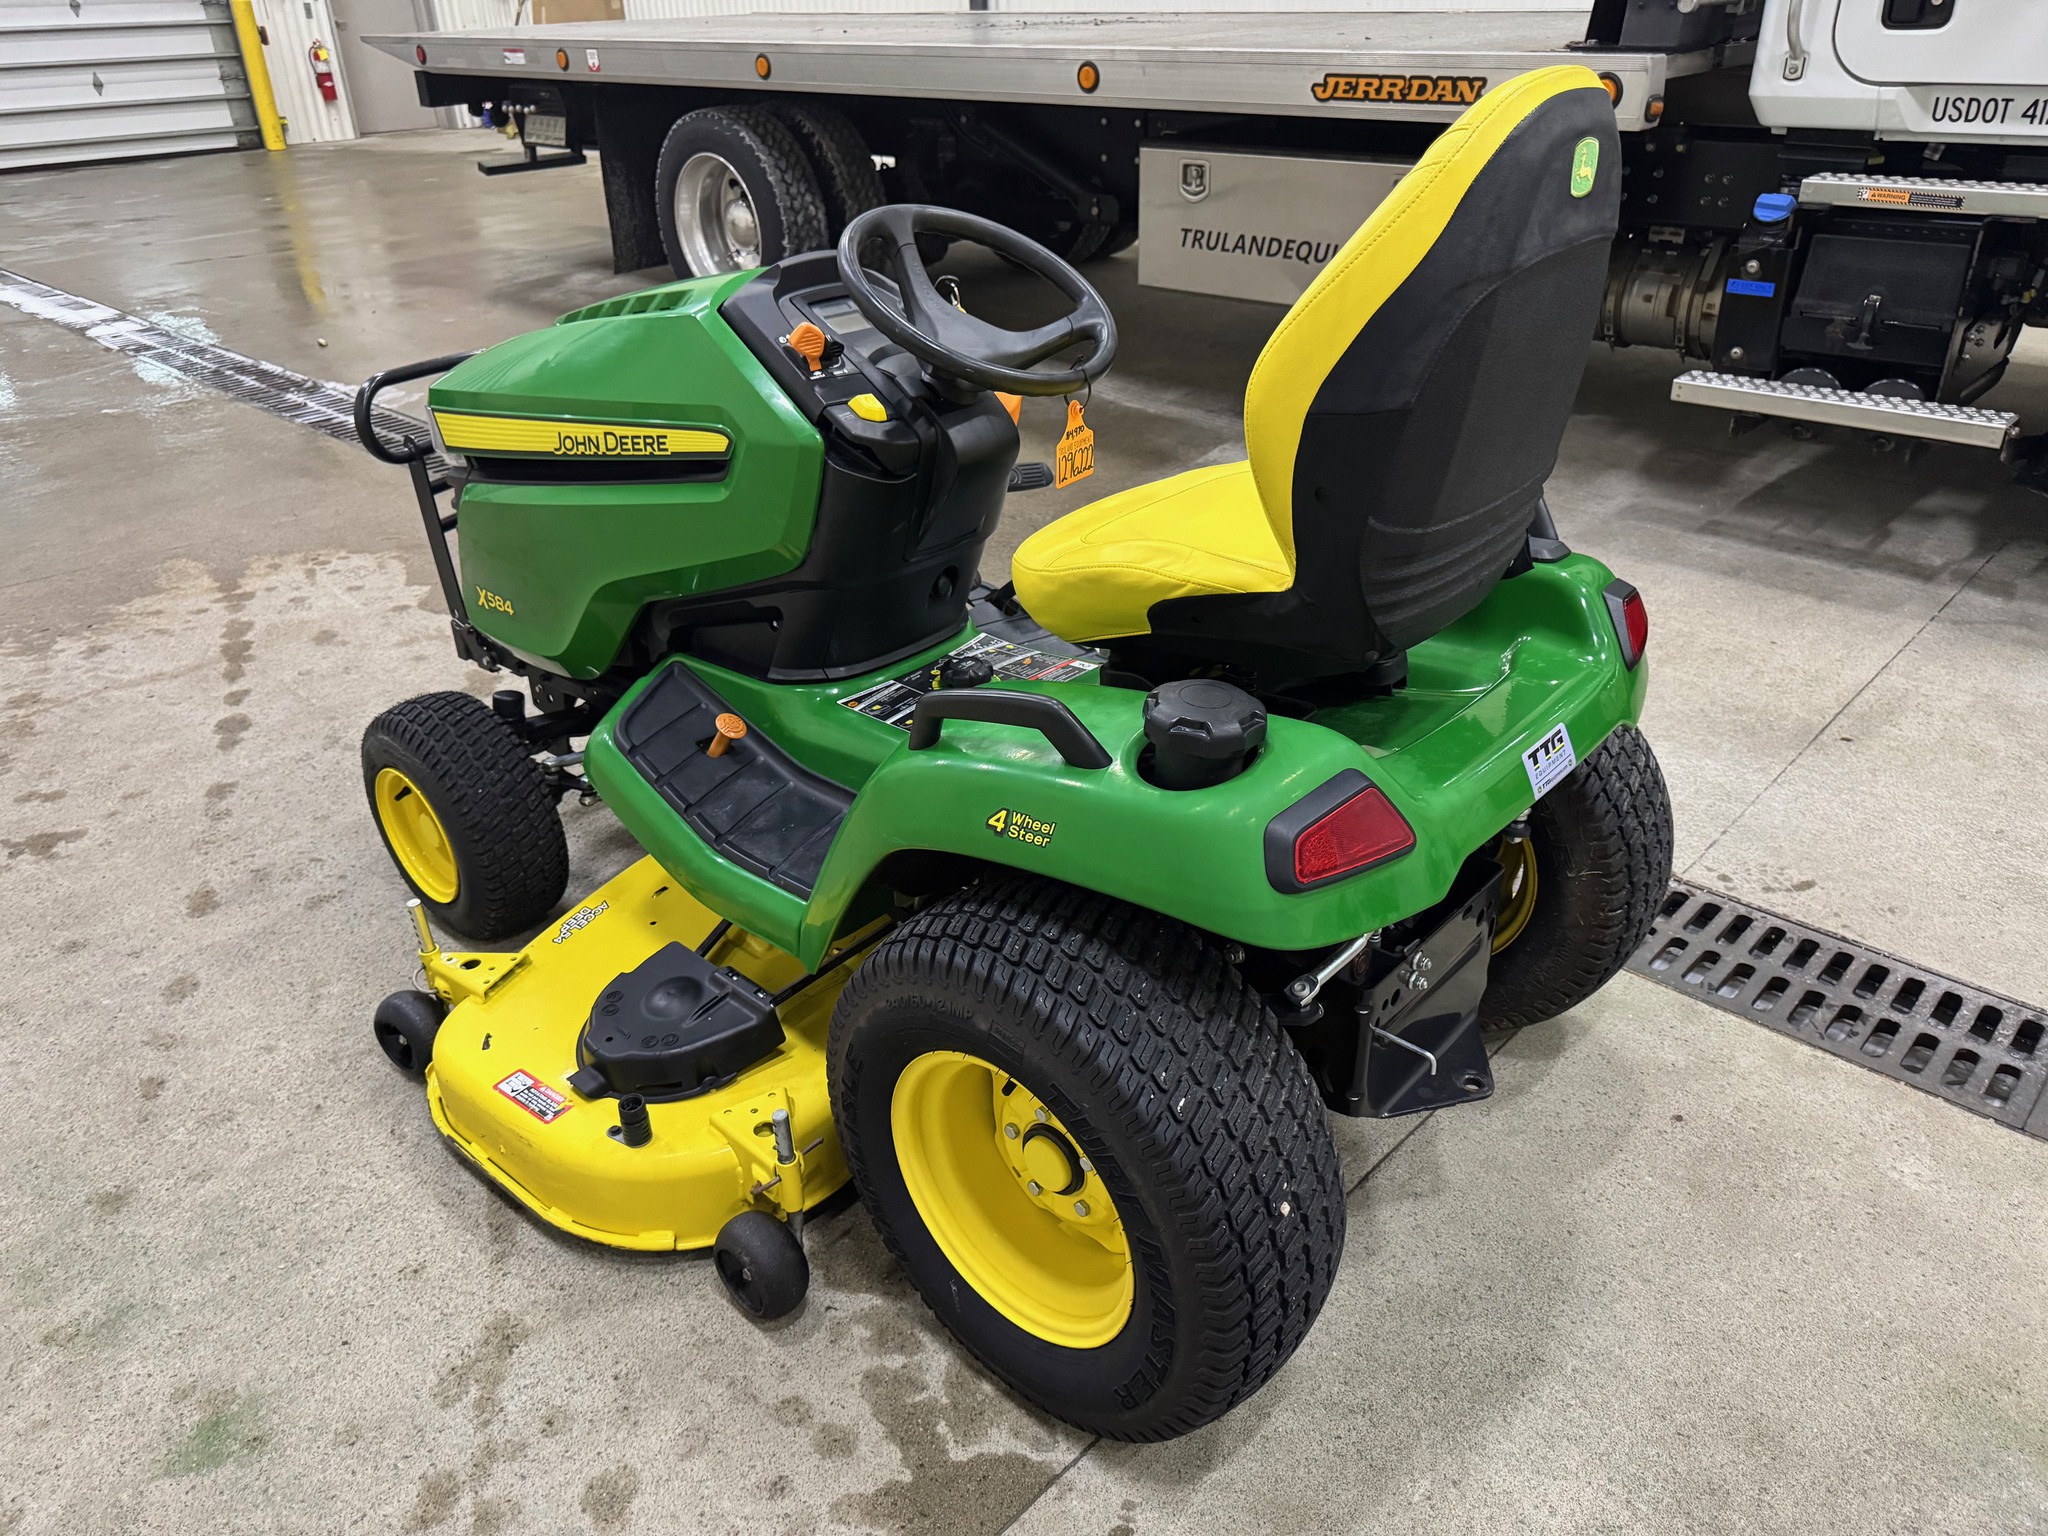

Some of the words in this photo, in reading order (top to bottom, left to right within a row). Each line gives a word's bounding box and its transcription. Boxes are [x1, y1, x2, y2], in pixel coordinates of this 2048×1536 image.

[1932, 97, 2015, 124] USDOT
[2021, 98, 2048, 125] 41
[1877, 192, 1906, 201] WARNING
[554, 432, 601, 453] JOHN
[603, 431, 670, 453] DEERE
[475, 585, 515, 616] X584
[1527, 728, 1565, 772] TTG
[1535, 749, 1567, 780] EQUIPMENT
[987, 809, 1008, 834] 4
[1012, 811, 1057, 836] Wheel
[1008, 825, 1051, 847] Steer
[560, 906, 593, 932] DEEP
[570, 900, 609, 931] ACCEL
[552, 930, 573, 944] 54
[1112, 1231, 1177, 1411] MASTER
